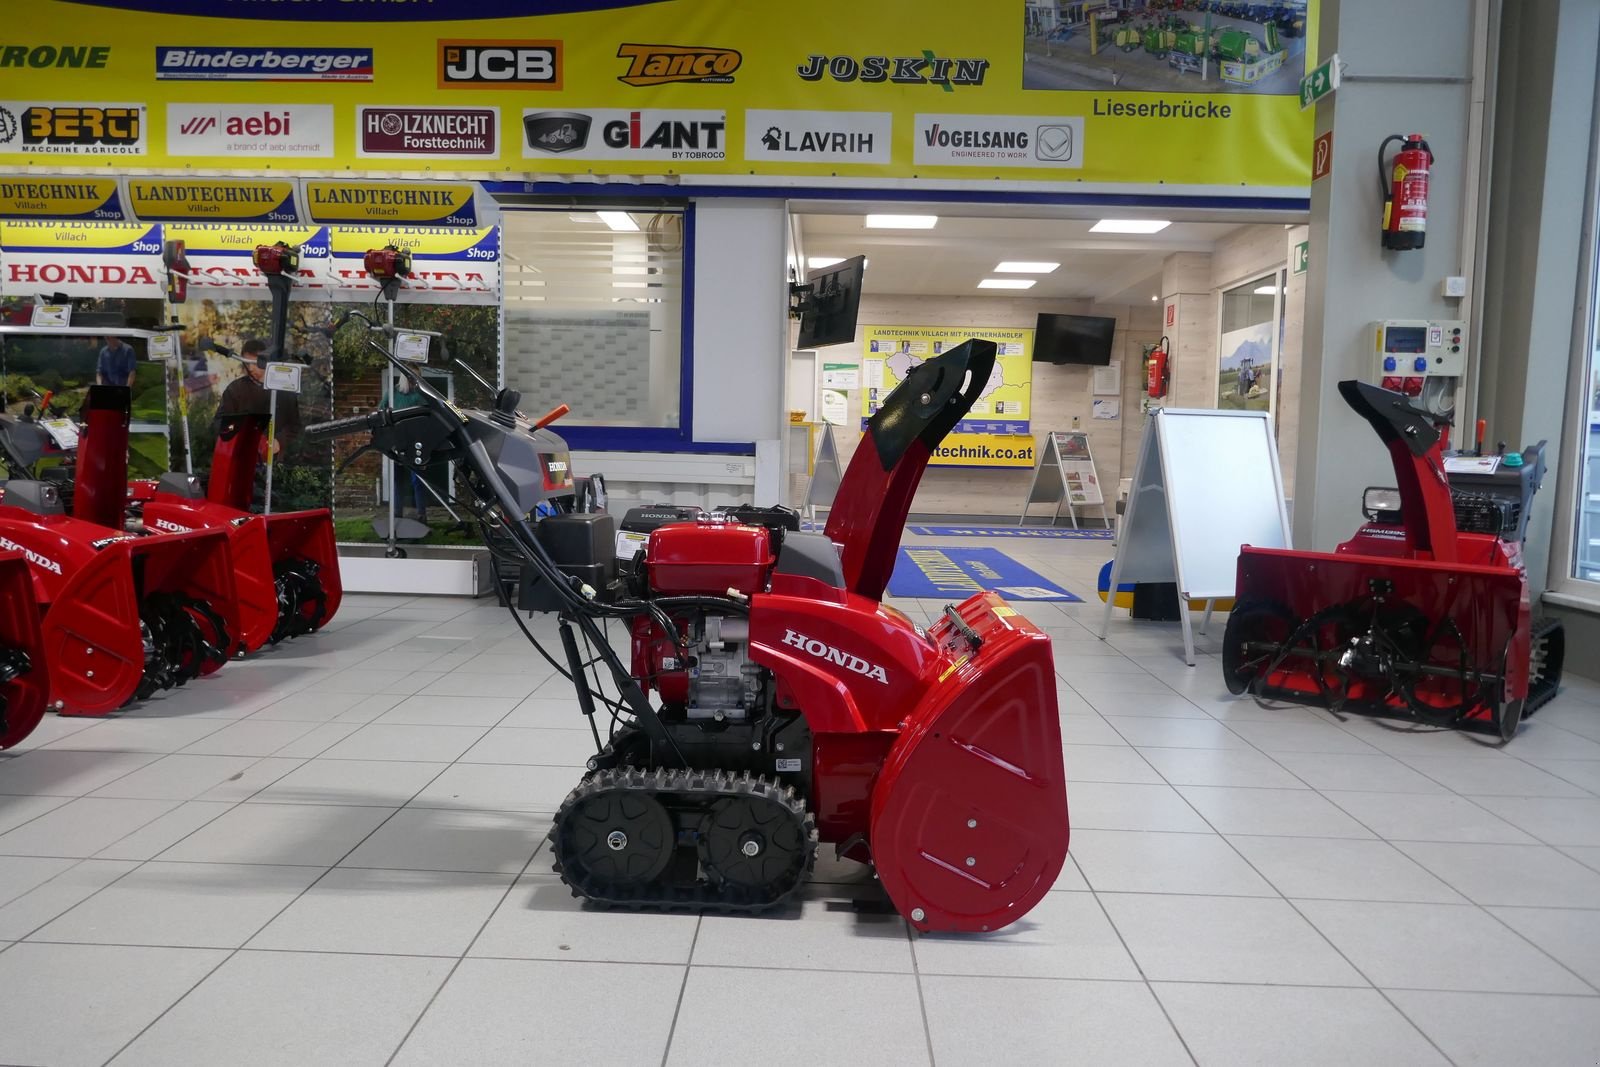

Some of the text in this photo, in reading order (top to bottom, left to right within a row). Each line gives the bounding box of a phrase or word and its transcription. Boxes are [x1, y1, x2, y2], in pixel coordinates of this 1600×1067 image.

[163, 51, 368, 73] Binderberger
[447, 50, 553, 79] JCB
[617, 43, 741, 80] Tanco
[797, 54, 990, 86] JOSKIN
[1093, 98, 1232, 119] Lieserbrücke
[226, 112, 290, 136] aebi
[368, 113, 488, 136] HOLZKNECHT
[404, 135, 486, 149] Forsttechnik
[785, 131, 873, 153] LAVRIH
[924, 123, 1029, 149] VOGELSANG
[233, 143, 257, 151] brand
[259, 143, 268, 151] of
[269, 143, 287, 151] aebi
[288, 143, 320, 152] schmidt
[951, 150, 995, 158] ENGINEERED
[136, 185, 273, 202] LANDTECHNIK
[314, 188, 455, 206] LANDTECHNIK
[14, 201, 47, 210] Villach
[187, 204, 220, 213] Villach
[365, 206, 399, 216] Villach
[94, 209, 121, 220] Shop
[268, 212, 295, 222] Shop
[446, 215, 474, 225] Shop
[55, 232, 87, 241] Villach
[220, 235, 253, 244] Villach
[388, 238, 421, 248] Villach
[132, 242, 160, 253] Shop
[300, 245, 327, 256] Shop
[466, 248, 495, 259] Shop
[8, 264, 157, 284] HONDA
[931, 445, 1032, 459] technik.co.at
[782, 629, 889, 684] HONDA
